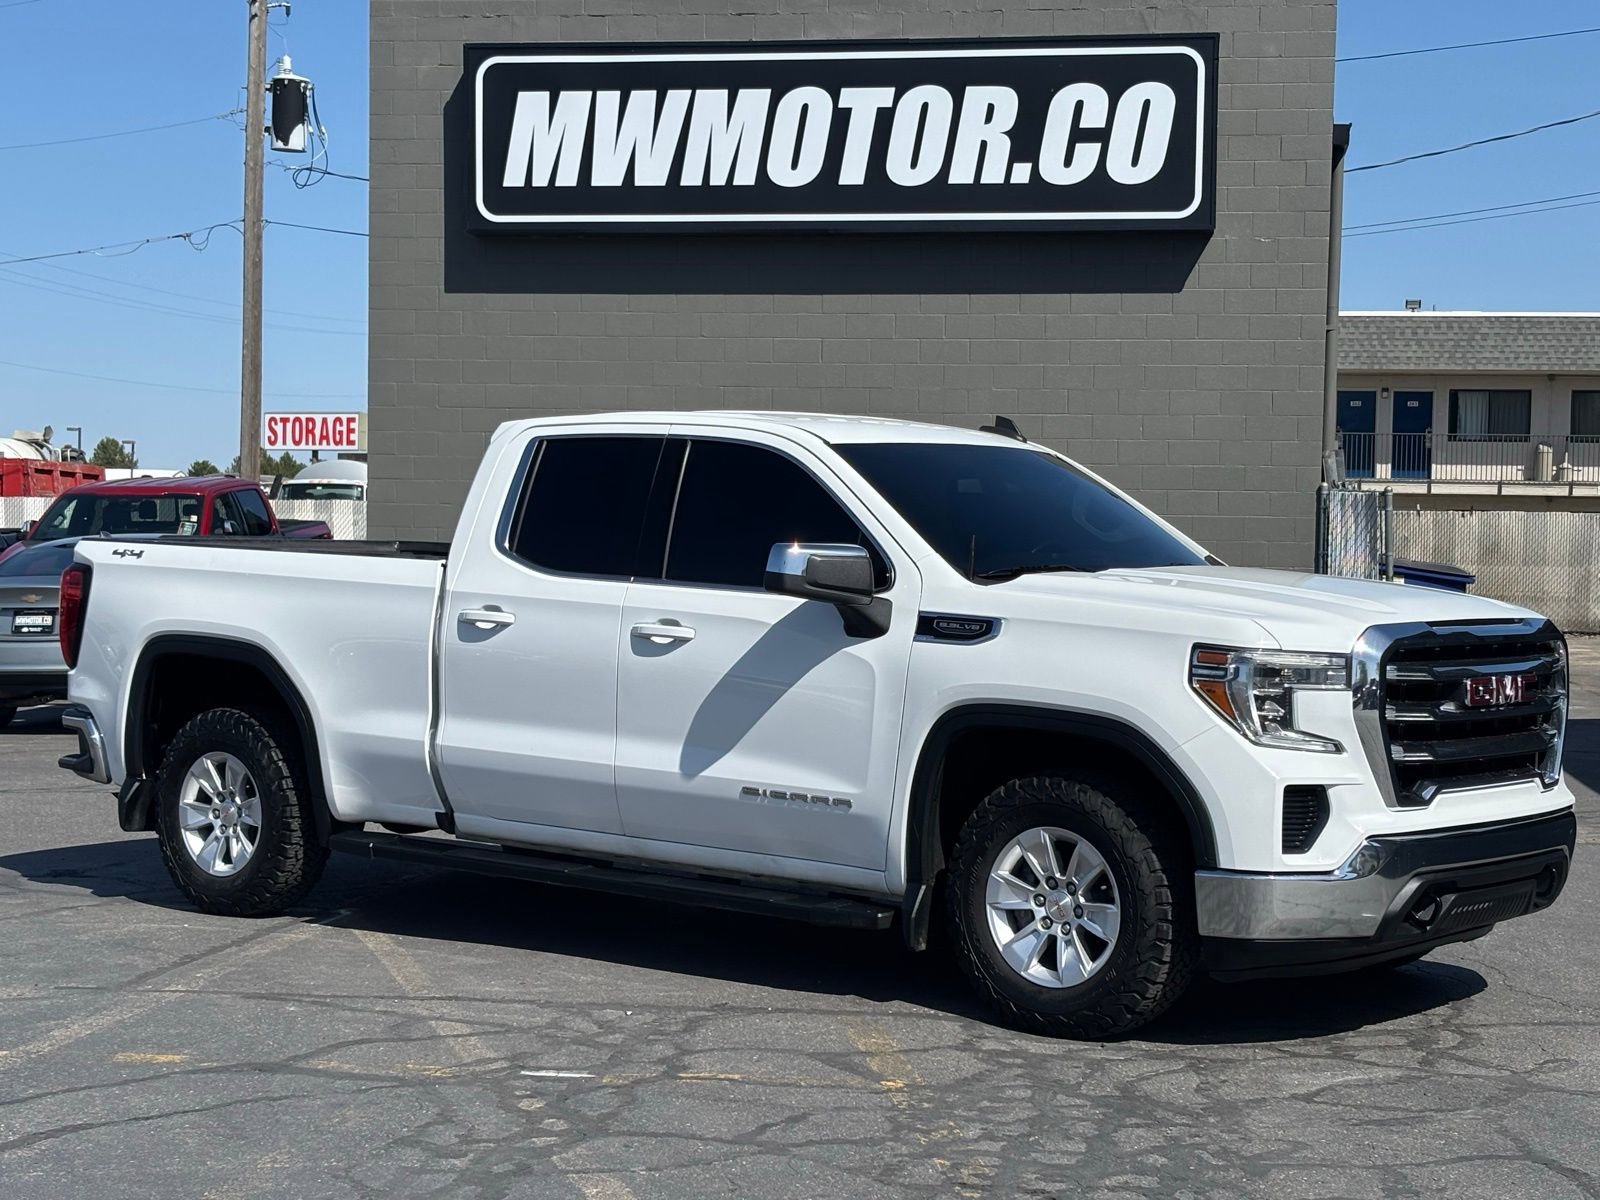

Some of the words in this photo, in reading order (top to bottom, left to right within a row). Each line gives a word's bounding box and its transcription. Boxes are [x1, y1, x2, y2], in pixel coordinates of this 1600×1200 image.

[502, 81, 1177, 188] MWMOTOR.CO
[267, 416, 357, 447] STORAGE
[1464, 673, 1538, 707] GMC
[740, 785, 853, 809] SIERRA
